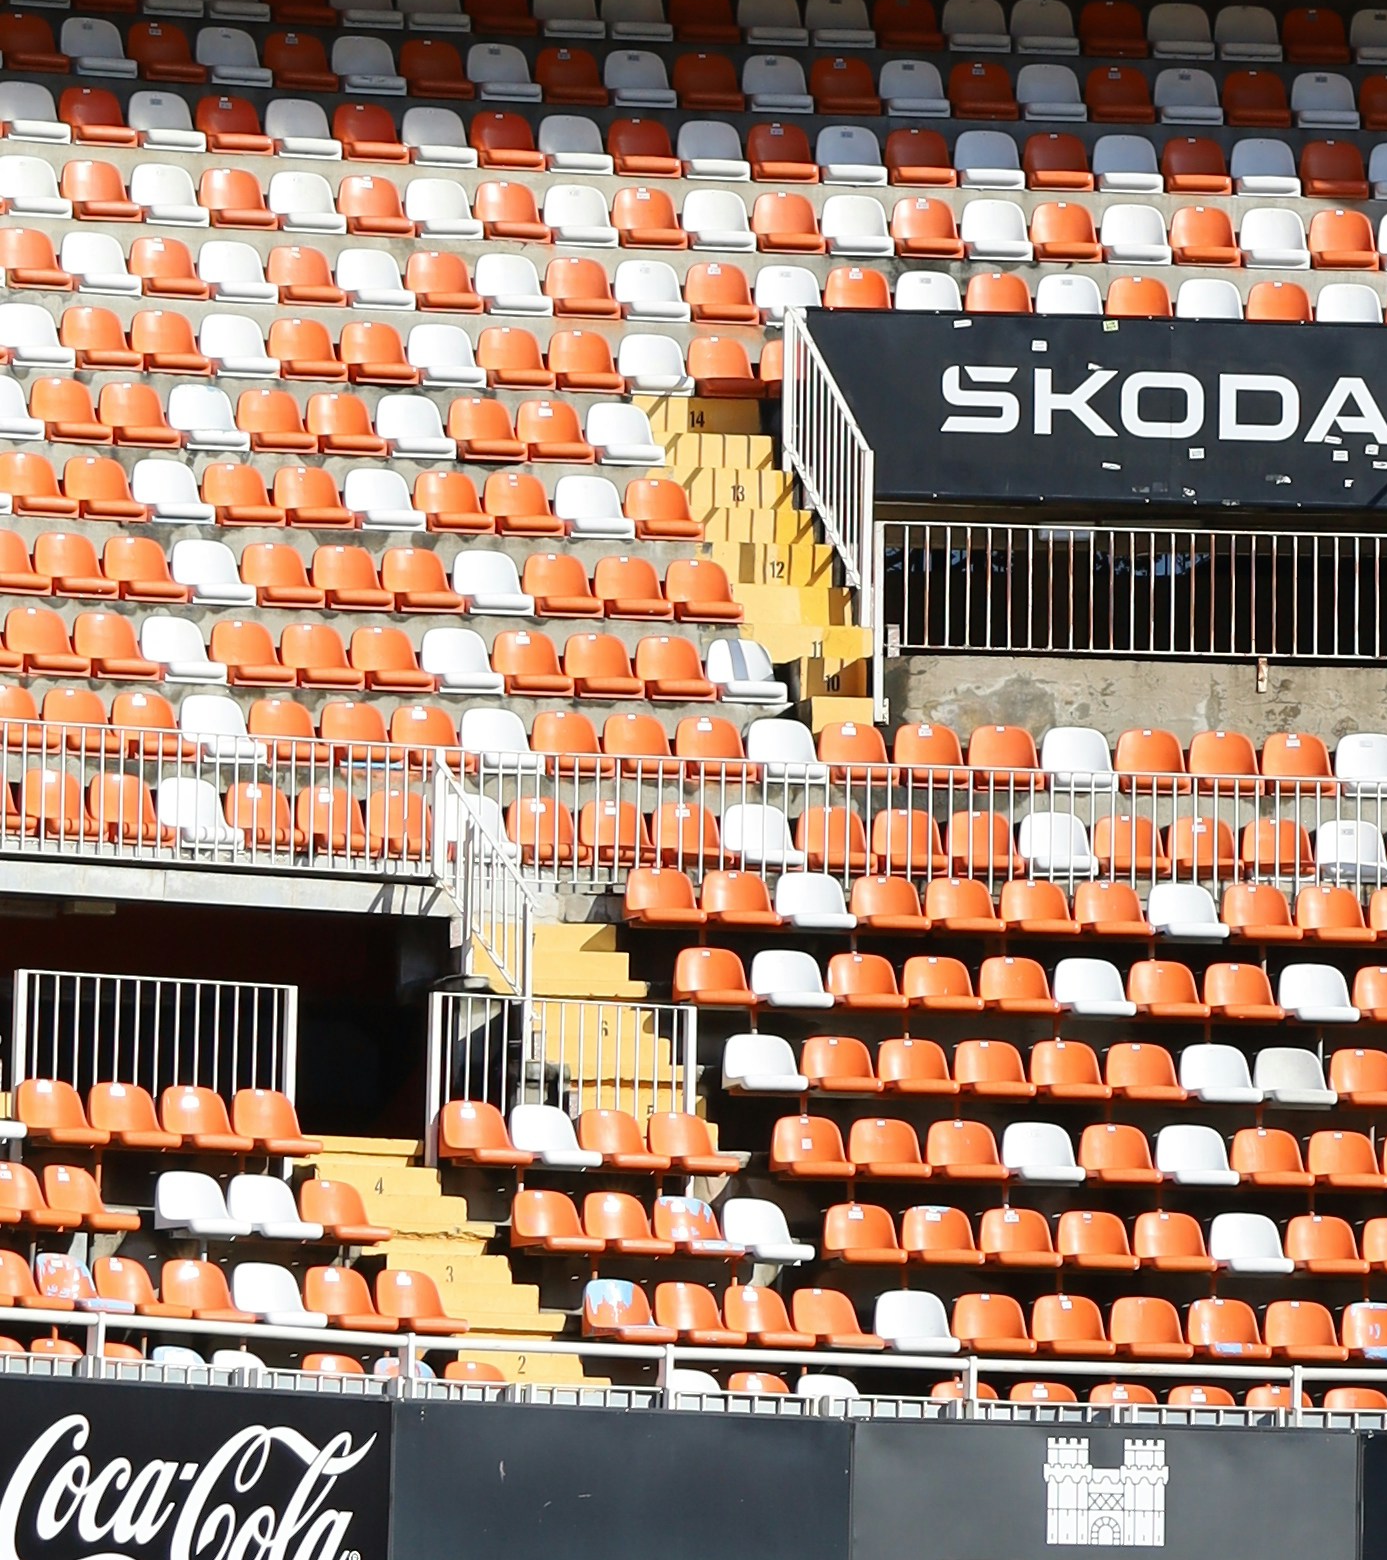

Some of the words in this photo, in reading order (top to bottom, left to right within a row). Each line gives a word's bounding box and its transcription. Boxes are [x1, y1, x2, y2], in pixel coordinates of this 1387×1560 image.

[690, 411, 705, 427] 14
[730, 485, 745, 502] 13
[770, 561, 785, 579] 12
[812, 641, 823, 657] 11
[825, 675, 840, 692] 10
[601, 1020, 609, 1037] 6
[374, 1177, 384, 1194] 4
[446, 1265, 454, 1283] 3
[517, 1356, 526, 1374] 2
